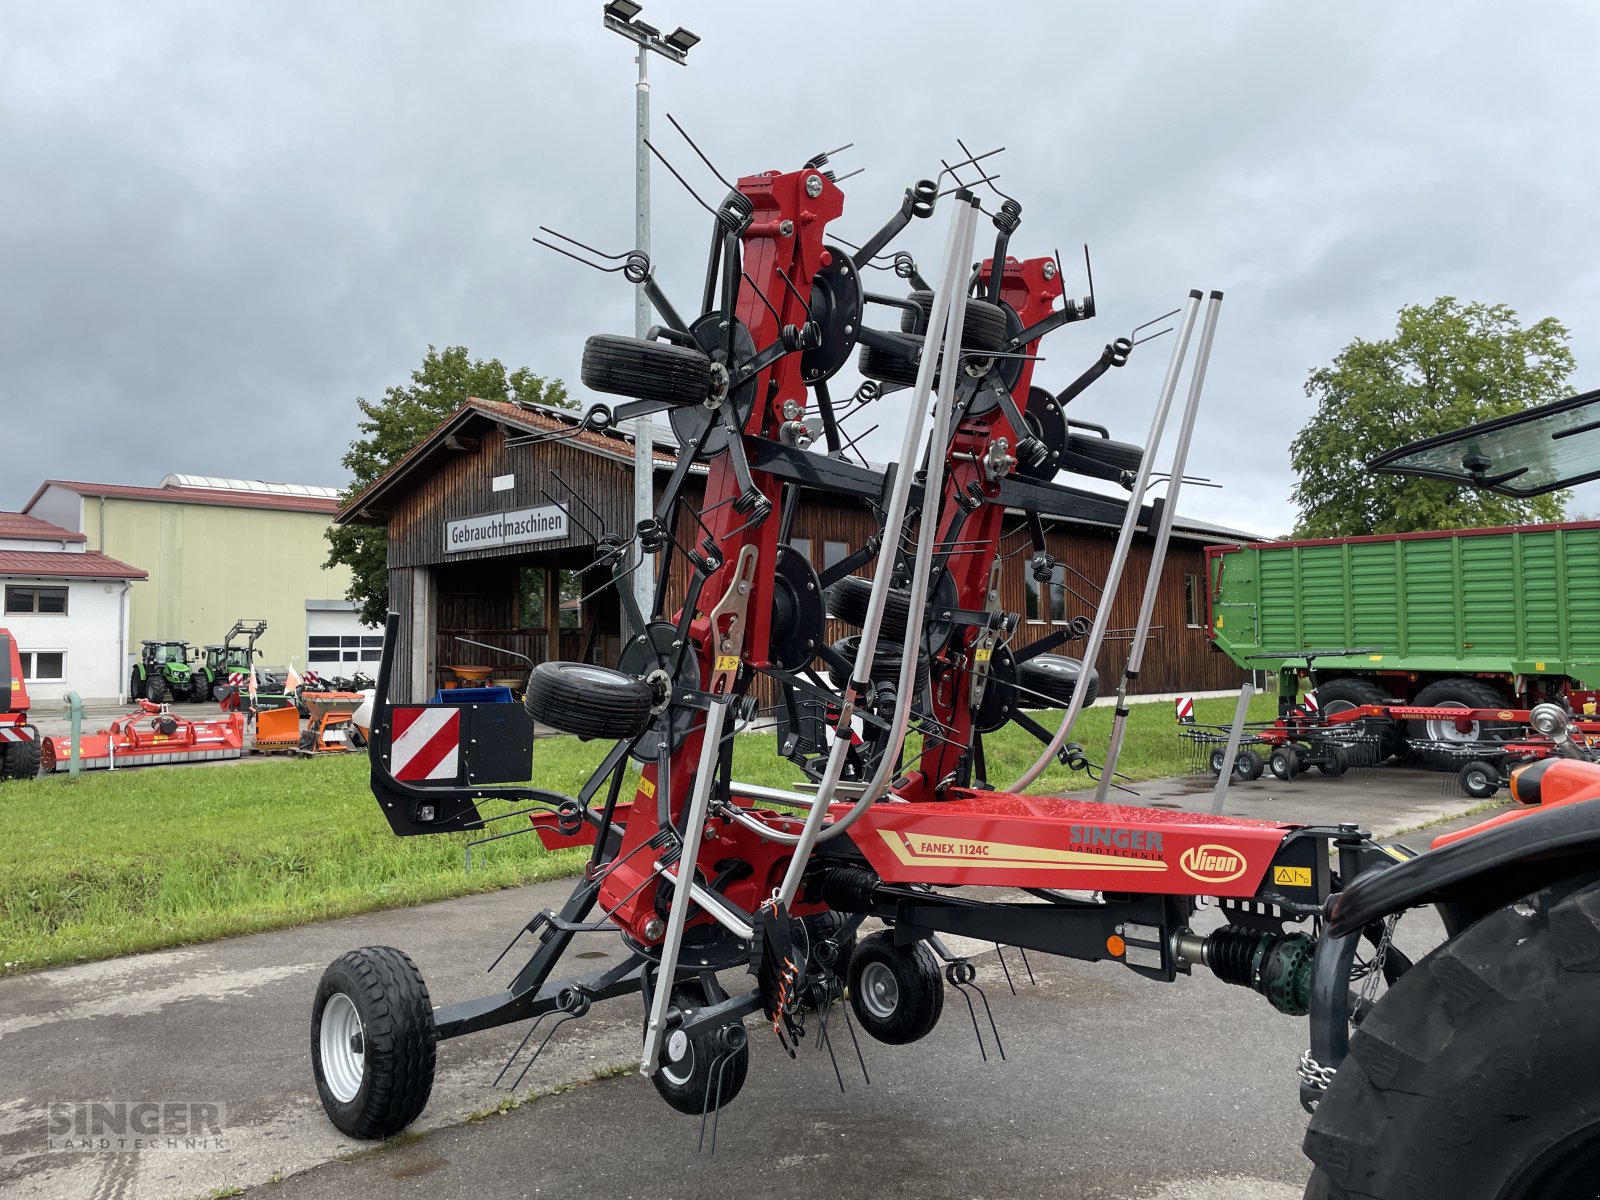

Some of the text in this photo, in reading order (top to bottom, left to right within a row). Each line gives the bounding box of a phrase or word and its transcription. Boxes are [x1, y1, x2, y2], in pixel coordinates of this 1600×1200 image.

[921, 842, 989, 856] FANEX 1124C
[1070, 824, 1163, 852] SINGER
[1069, 845, 1164, 861] LANDTECHNIK
[1188, 845, 1239, 873] Vicon
